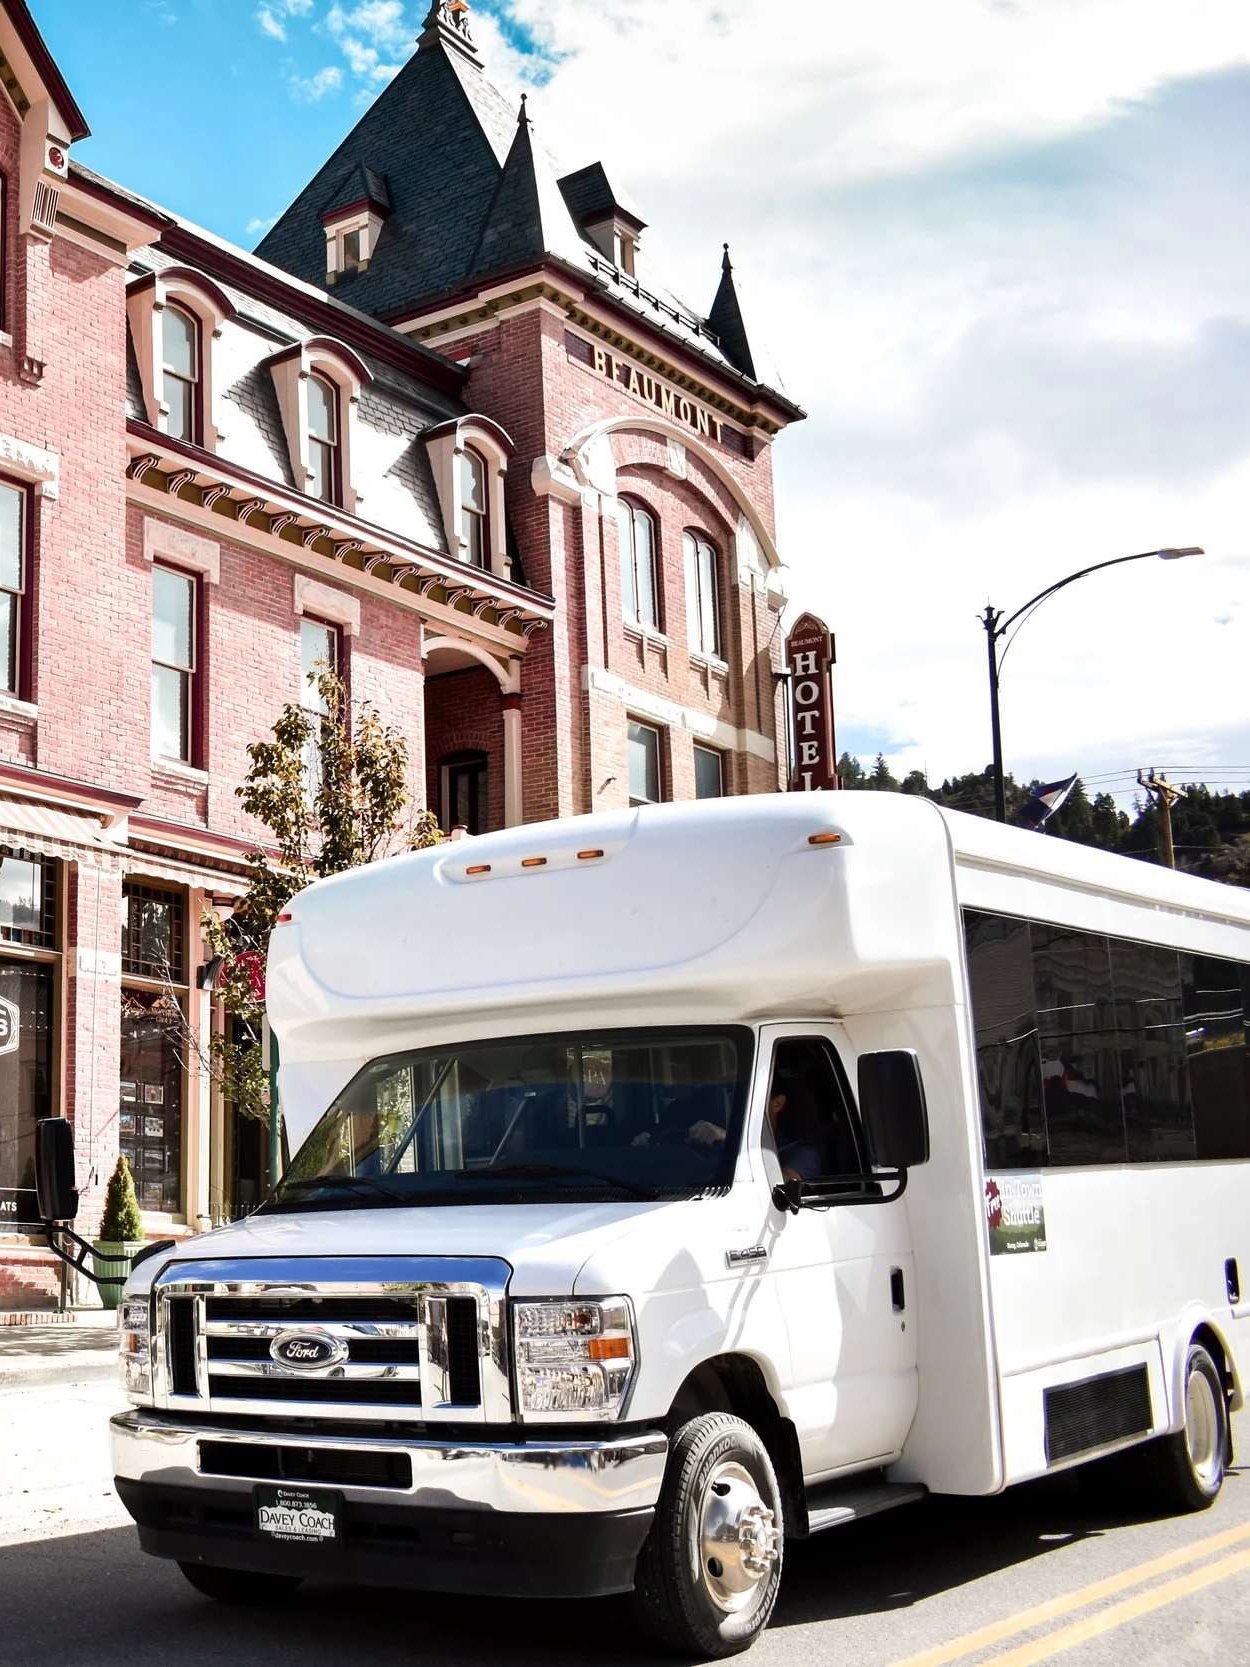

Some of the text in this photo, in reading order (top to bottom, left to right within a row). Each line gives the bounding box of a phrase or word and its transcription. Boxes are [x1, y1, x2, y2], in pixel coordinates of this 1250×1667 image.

[592, 345, 724, 444] BEAUMONT
[790, 636, 823, 648] BEAUMONT
[792, 650, 822, 791] HOTEL
[1001, 1179, 1042, 1199] In-Town
[1003, 1204, 1040, 1226] Shuttle
[286, 1340, 318, 1358] Ford
[260, 1509, 334, 1530] DAVEY COACH
[275, 1532, 318, 1542] daveycoach.com
[298, 1527, 322, 1535] LEASING
